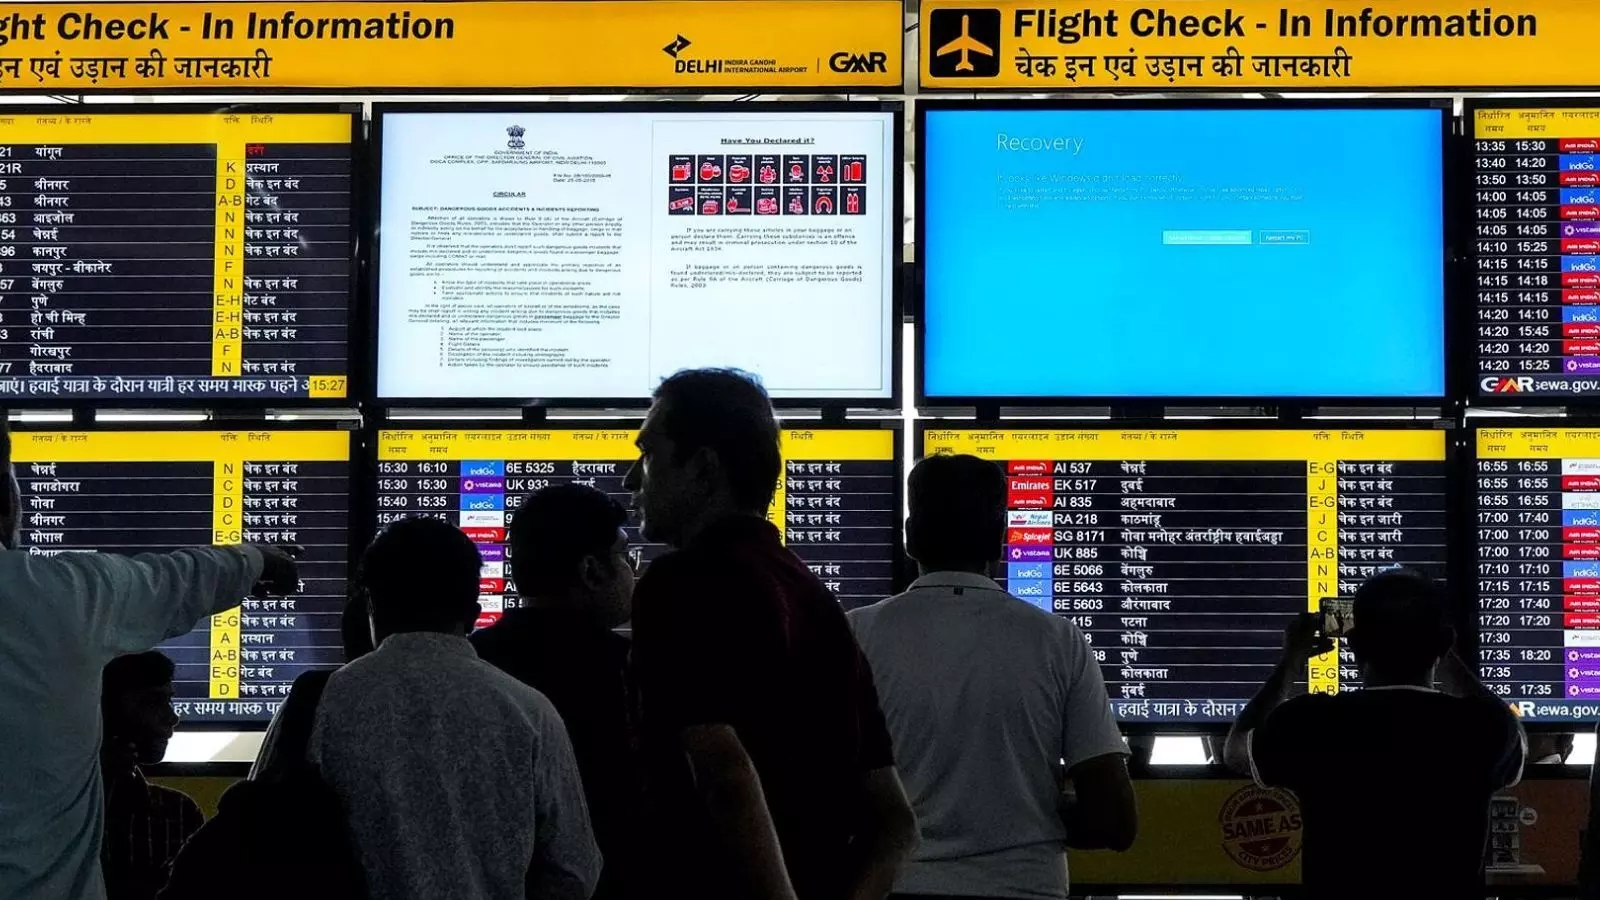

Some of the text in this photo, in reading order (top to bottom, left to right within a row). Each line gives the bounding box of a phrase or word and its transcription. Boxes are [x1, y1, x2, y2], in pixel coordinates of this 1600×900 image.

[58, 13, 169, 40] Check
[203, 12, 233, 39] In
[248, 11, 453, 39] Information
[1015, 9, 1118, 42] Flight
[1130, 9, 1244, 37] Check
[1280, 9, 1310, 36] In
[1326, 8, 1536, 37] Information
[30, 48, 272, 84] एवं उड़ान की जानकारी
[675, 60, 722, 73] DELHI
[829, 52, 887, 72] GMR
[1015, 47, 1352, 82] चेक इन एवं उड़ान की जानकारी
[998, 134, 1083, 155] Recovery
[1476, 141, 1545, 151] 13:35 15:30
[35, 145, 63, 158] यांगून
[227, 162, 279, 172] K प्रस्थान
[1476, 158, 1546, 168] 13:40 14:20
[35, 177, 299, 190] श्रीनगर D चेक इन बंद
[34, 194, 278, 206] श्रीनगर A-B गेट बंद
[34, 210, 74, 224] आइजोल
[32, 247, 67, 259] कानपुर
[1477, 242, 1547, 252] 14:10 15:25
[32, 264, 63, 275] जयपुर
[73, 260, 112, 272] बीकानेर
[225, 262, 233, 272] F
[32, 276, 64, 292] बेंगलुरु
[31, 294, 240, 308] पुणे E-H
[31, 310, 86, 325] हो ची मिन्ह
[30, 327, 54, 339] रांची
[30, 343, 72, 358] गोरखपुर
[29, 360, 73, 375] हैदराबाद
[1479, 360, 1550, 370] 14:20 15:25
[28, 376, 345, 394] हवाई यात्रा के दौरान यात्री हर समय मास्क पहने 15:27
[31, 463, 233, 476] चेन्नई N
[379, 463, 408, 472] 15:30
[418, 463, 447, 472] 16:10
[506, 463, 522, 473] 6E
[526, 463, 554, 473] 5325
[572, 461, 616, 475] हैदराबाद
[1054, 461, 1393, 474] AI 537 चेन्नई E-G चेक इन बंद
[1478, 461, 1548, 471] 16:55 16:55
[31, 479, 233, 492] बागडोगरा C
[378, 480, 407, 489] 15:30
[418, 480, 447, 489] 15:30
[507, 480, 524, 490] UK
[1012, 478, 1325, 492] Emirates EK 517 दुबई J
[30, 496, 297, 509] गोवा D चेक इन बंद
[378, 497, 521, 507] 15:40 15:35 6E
[1054, 497, 1176, 509] AI 835 अहमदाबाद
[30, 513, 65, 525] श्रीनगर
[1055, 512, 1402, 526] RA 218 काठमांडू चेक इन जारी
[1478, 513, 1548, 522] 17:00 17:40
[30, 530, 63, 542] भोपाल
[1055, 531, 1073, 541] SG
[1077, 531, 1104, 541] 8171
[1121, 529, 1145, 541] गोवा
[1148, 529, 1182, 543] मनोहर
[1317, 531, 1327, 542] C
[1054, 563, 1153, 578] 6E 5066 बेंगलुरु
[1121, 598, 1171, 610] औरंगाबाद
[1480, 599, 1550, 608] 17:20 17:40
[1121, 618, 1148, 627] पटना
[221, 633, 274, 643] A प्रस्थान
[1121, 684, 1145, 698] मुंबई
[174, 702, 262, 716] हर समय मास्क
[1118, 700, 1236, 718] हवाई यात्रा के दौरान
[1223, 814, 1302, 840] SAME AS
